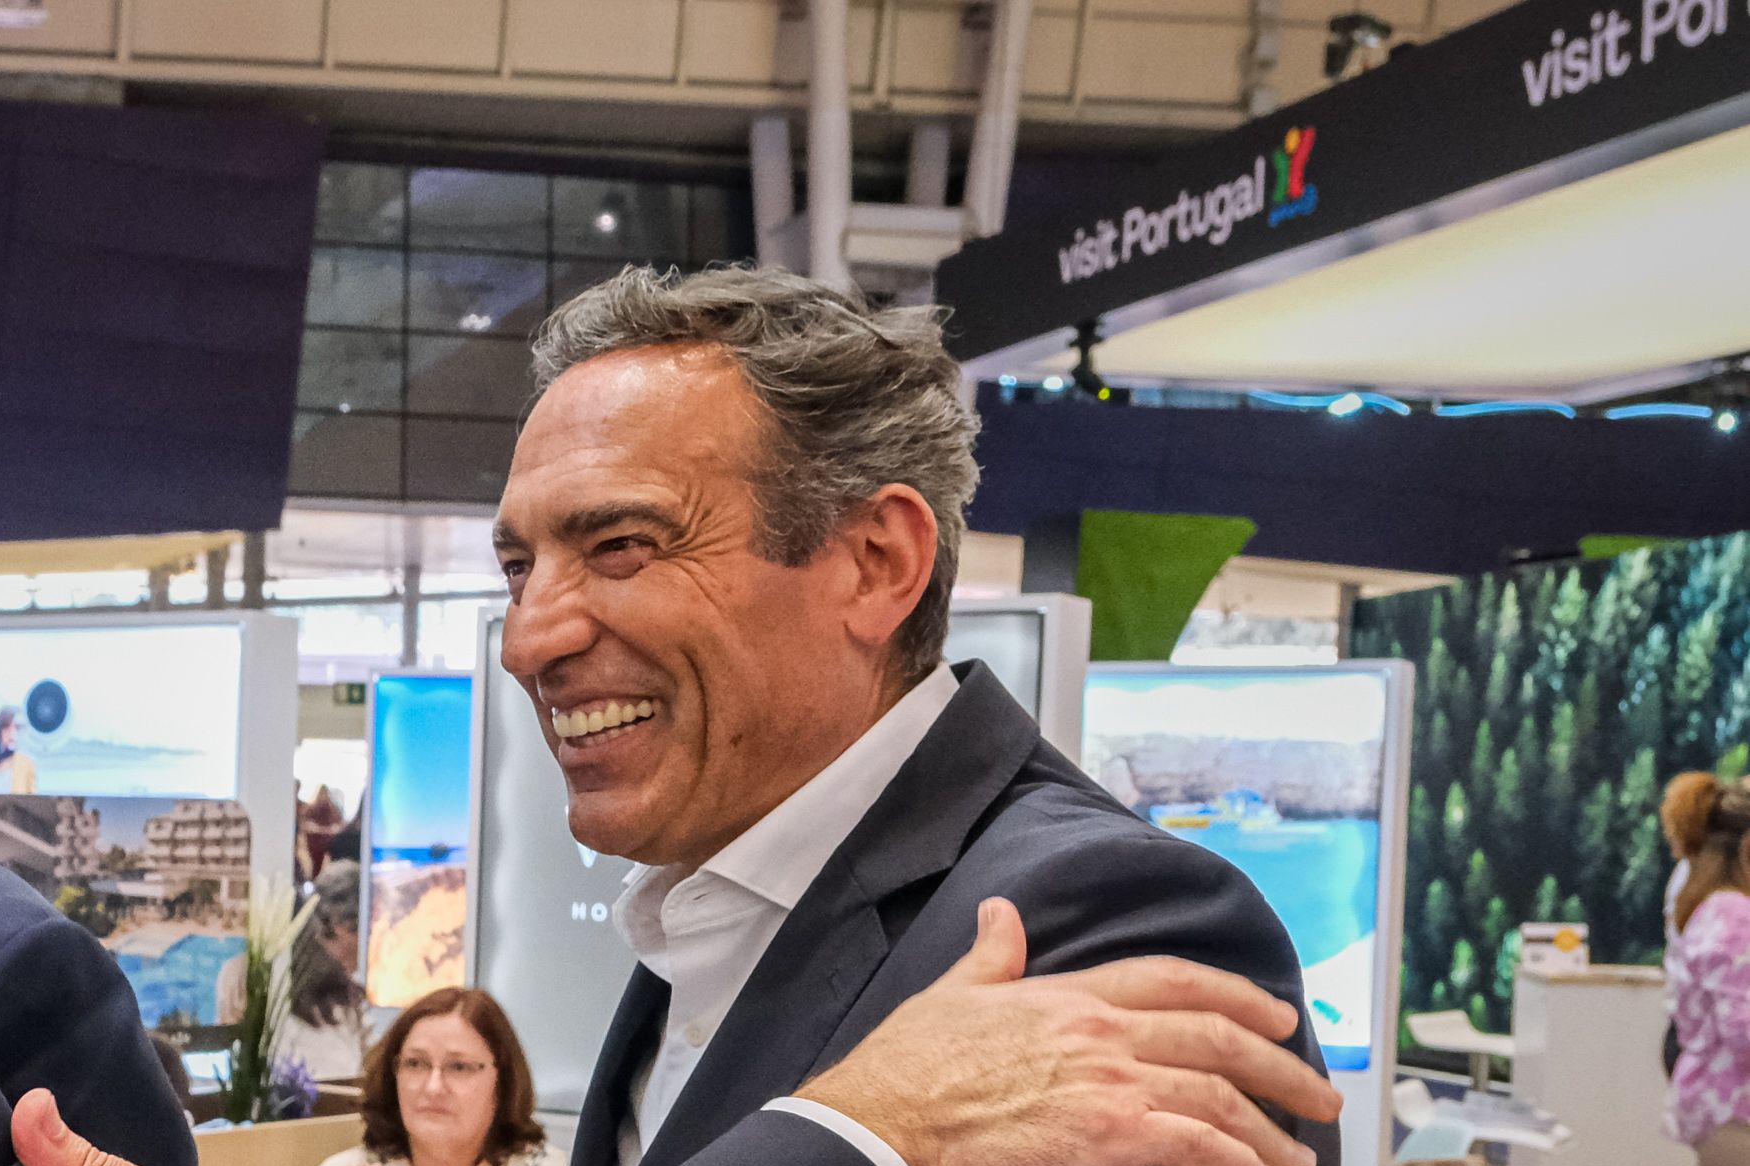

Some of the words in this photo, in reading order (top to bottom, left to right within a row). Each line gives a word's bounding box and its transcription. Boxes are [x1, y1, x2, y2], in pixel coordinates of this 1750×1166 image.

[1521, 10, 1632, 107] visit
[1058, 219, 1119, 284] visit
[1121, 155, 1266, 263] Portugal
[571, 901, 609, 922] HO
